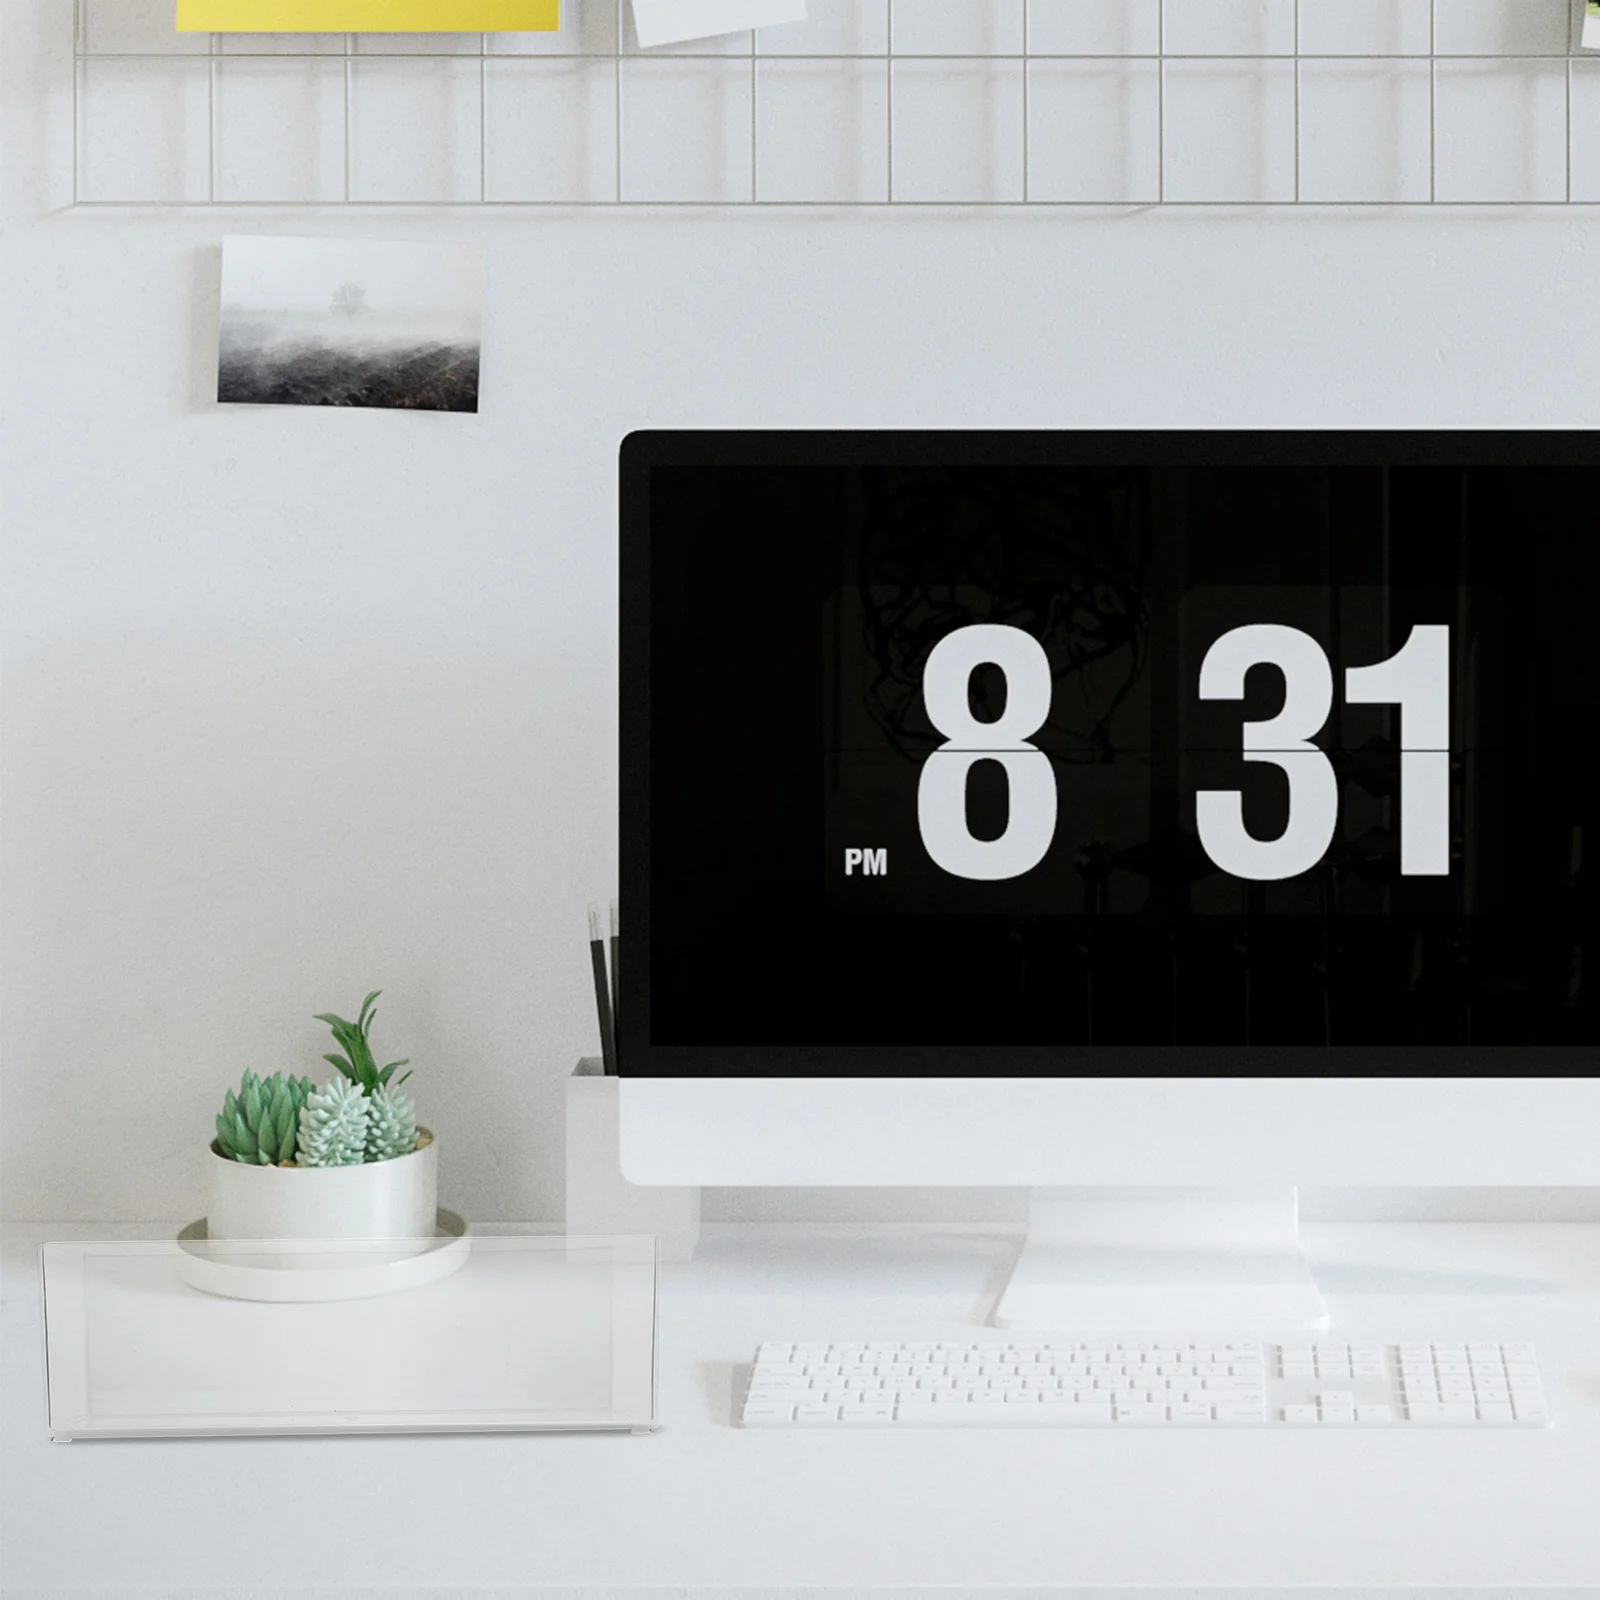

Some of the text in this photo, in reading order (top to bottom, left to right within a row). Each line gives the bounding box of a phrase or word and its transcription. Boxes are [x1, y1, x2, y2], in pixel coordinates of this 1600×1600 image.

[917, 623, 1450, 881] 8 31
[845, 848, 887, 876] PM
